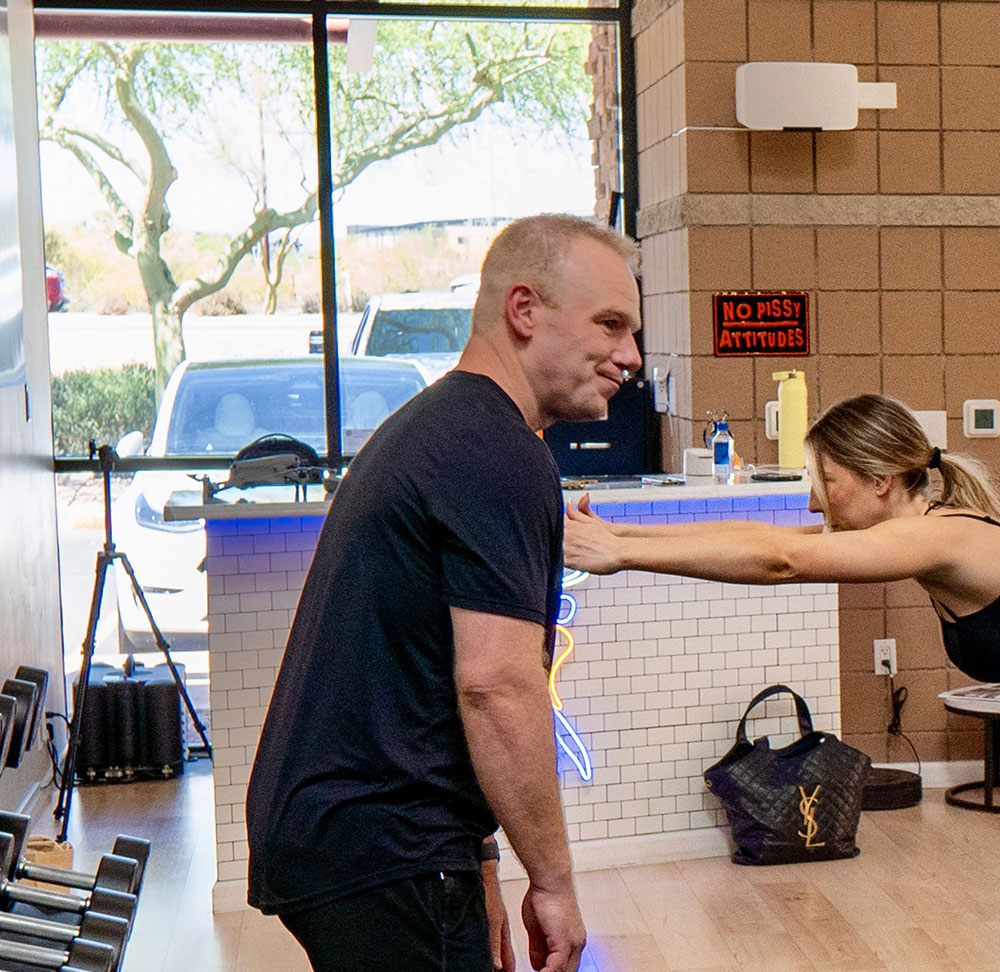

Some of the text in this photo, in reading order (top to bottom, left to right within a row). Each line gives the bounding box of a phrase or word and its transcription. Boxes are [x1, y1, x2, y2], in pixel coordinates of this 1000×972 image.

[722, 301, 752, 321] NO
[719, 327, 804, 348] ATTITUDES
[797, 784, 826, 848] YSL
